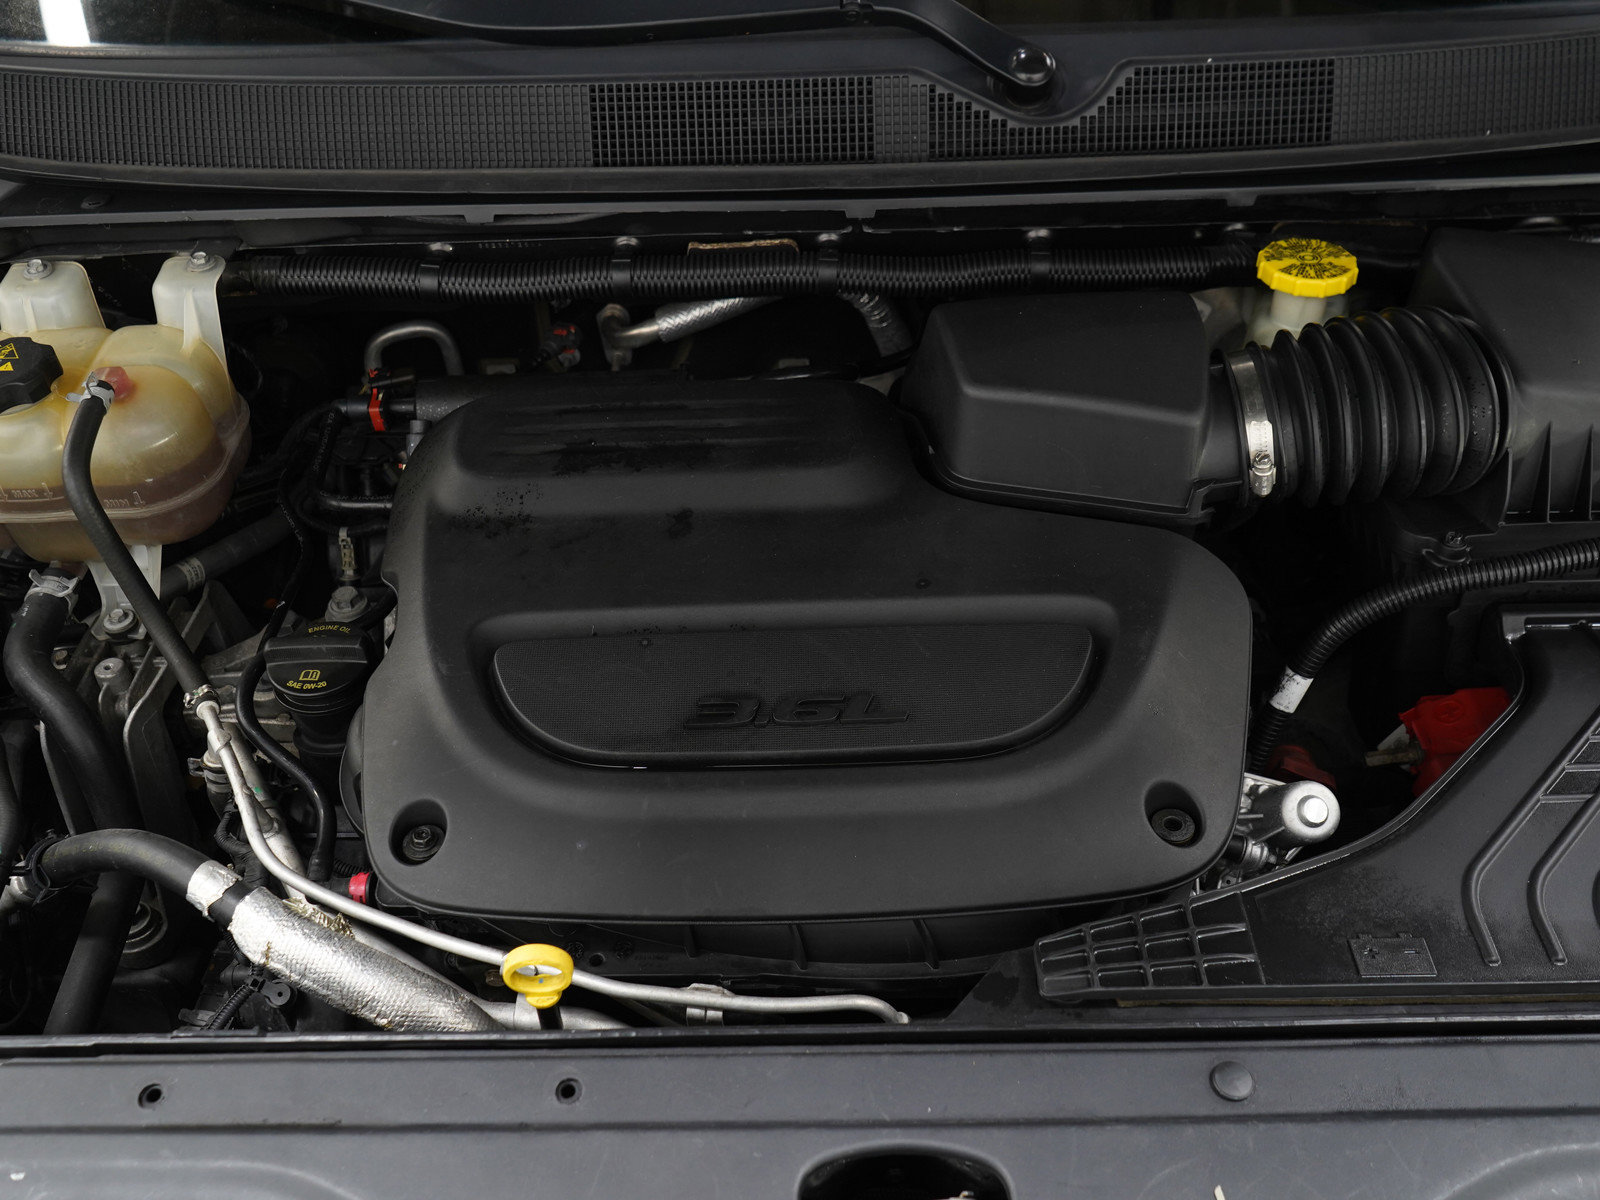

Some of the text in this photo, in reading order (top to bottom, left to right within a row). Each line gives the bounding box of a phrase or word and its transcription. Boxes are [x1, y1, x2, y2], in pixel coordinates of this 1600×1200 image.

[308, 624, 352, 634] ENGINE OIL
[286, 680, 327, 690] SAE 0W-20
[684, 694, 910, 729] 3.6L
